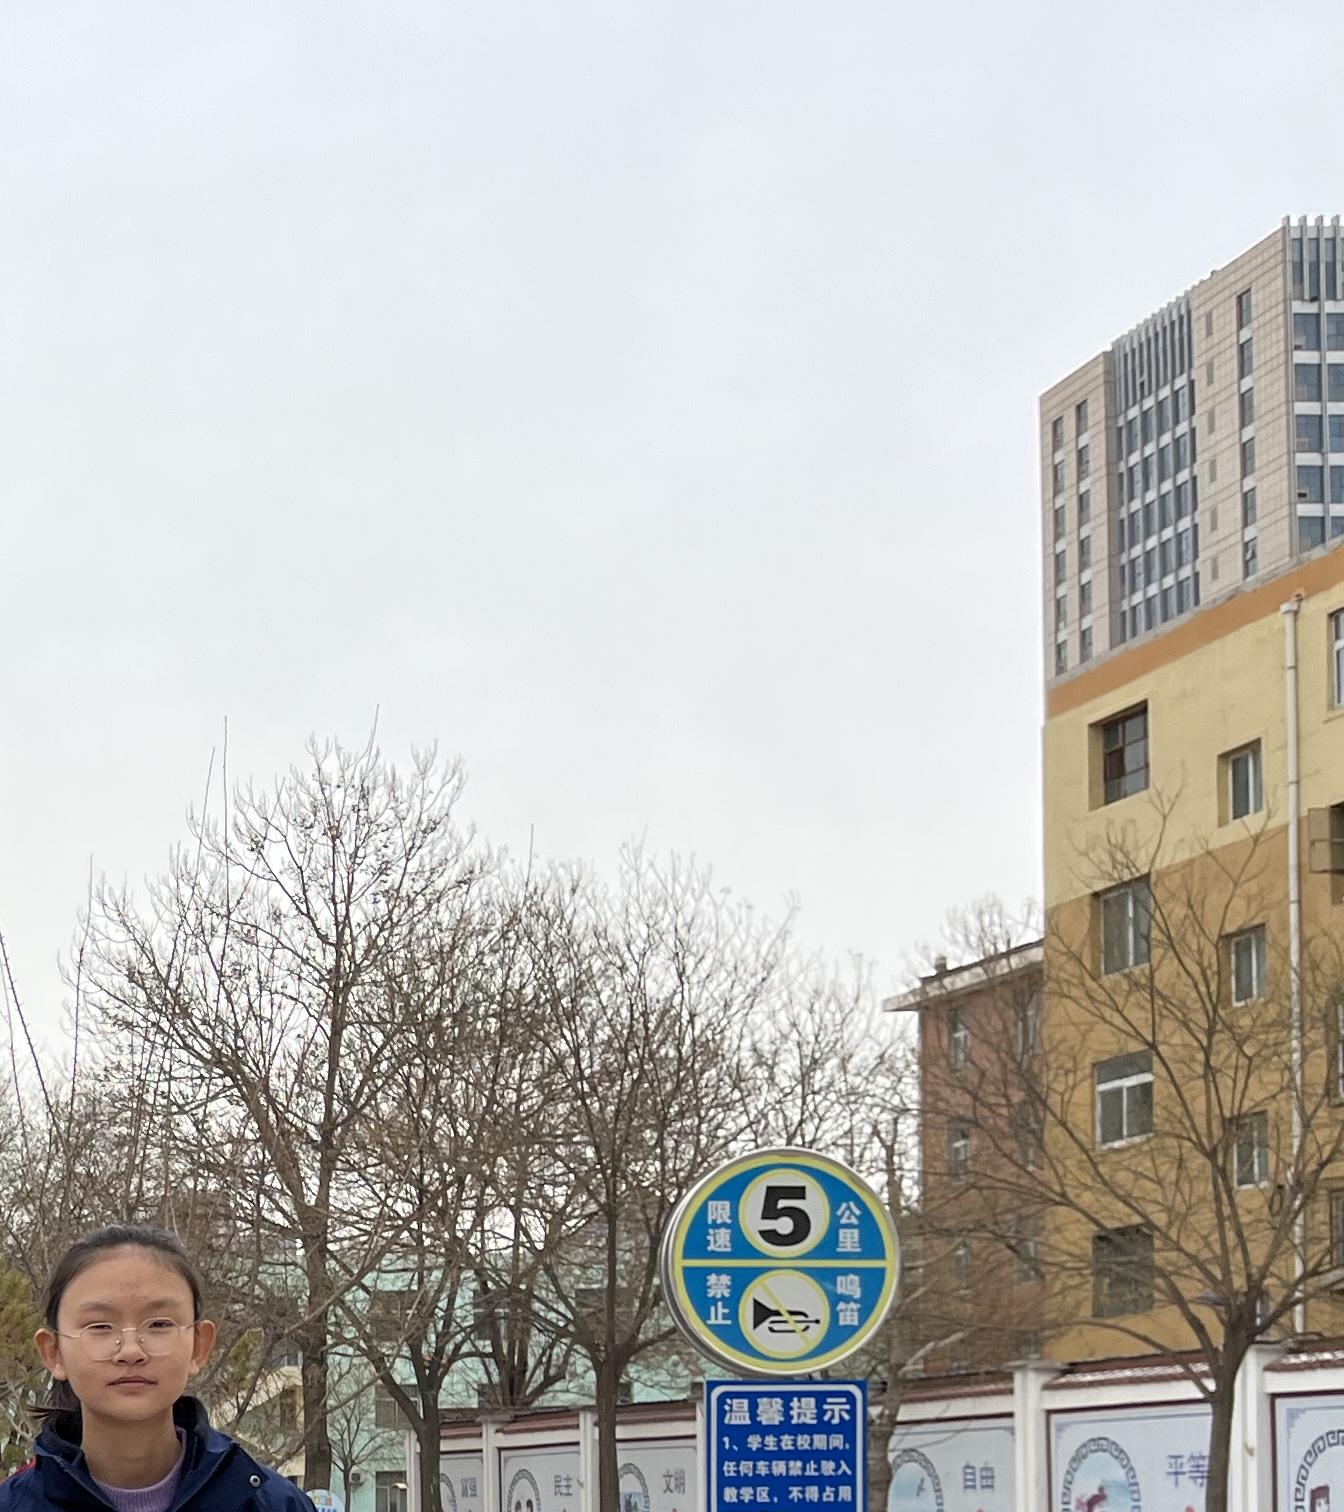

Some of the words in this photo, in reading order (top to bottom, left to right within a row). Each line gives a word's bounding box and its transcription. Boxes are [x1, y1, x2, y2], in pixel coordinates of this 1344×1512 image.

[706, 1200, 732, 1253] 限速
[757, 1185, 812, 1247] 5
[836, 1201, 862, 1253] 公里
[706, 1273, 732, 1325] 禁止
[836, 1273, 862, 1327] 鸣笛
[723, 1396, 851, 1425] 温馨提示
[662, 1469, 686, 1496] 文明
[722, 1460, 852, 1478] 任何车辆禁止驶入
[963, 1461, 995, 1490] 自由
[1166, 1450, 1208, 1488] 平等
[554, 1473, 573, 1497] 民主
